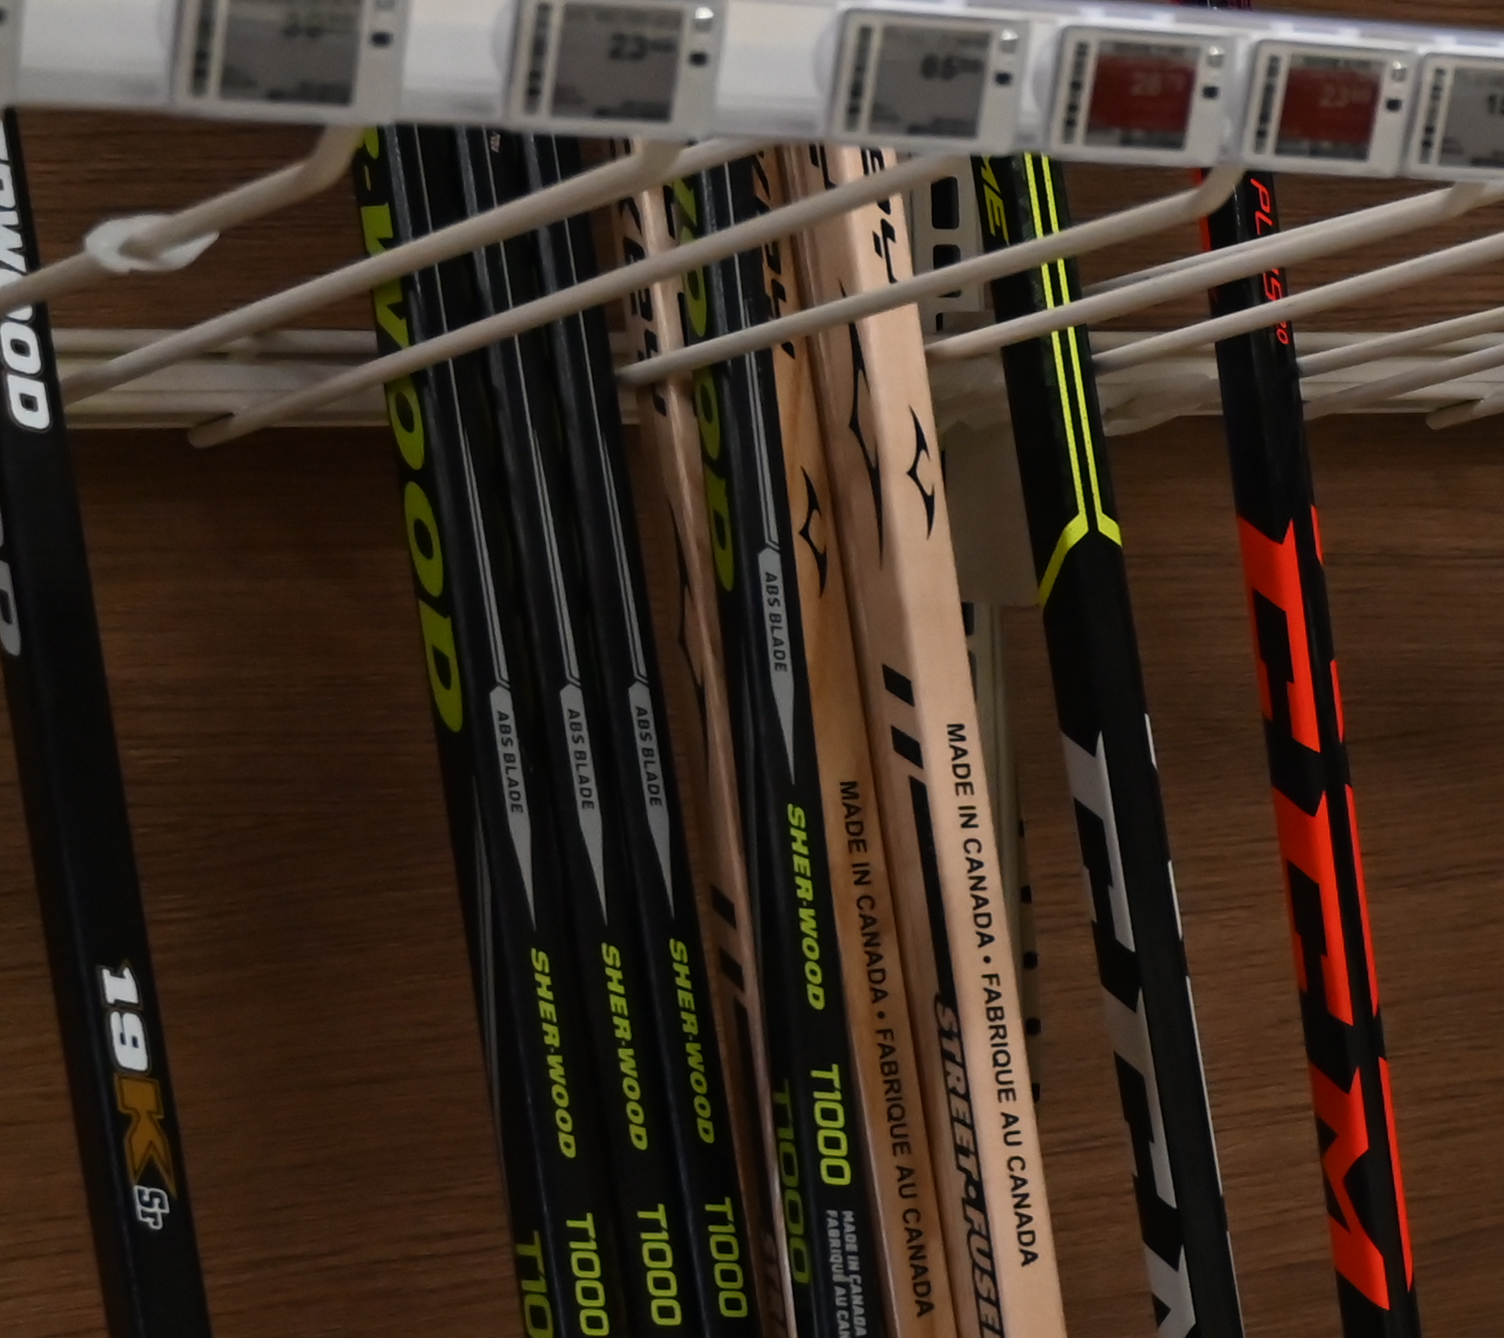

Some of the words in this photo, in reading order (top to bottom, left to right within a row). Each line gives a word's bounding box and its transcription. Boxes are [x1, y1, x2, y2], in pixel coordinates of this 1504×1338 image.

[765, 571, 781, 607] ABS
[770, 612, 787, 672] BLADE
[945, 722, 976, 798] MADE
[958, 804, 980, 831] IN
[787, 803, 826, 1011] SHER-WOOD
[962, 837, 996, 951] CANADA
[531, 948, 576, 1159] SHER-WOOD
[602, 942, 648, 1151] SHER-WOOD
[670, 938, 715, 1145] SHER-WOOD
[982, 973, 1018, 1103] FABRIQUE
[811, 1064, 852, 1186] T1000
[1001, 1110, 1024, 1147] AU
[637, 1203, 682, 1326] T1000
[705, 1196, 748, 1318] T1000
[1005, 1153, 1041, 1269] CANADA
[566, 1212, 609, 1337] T1000
